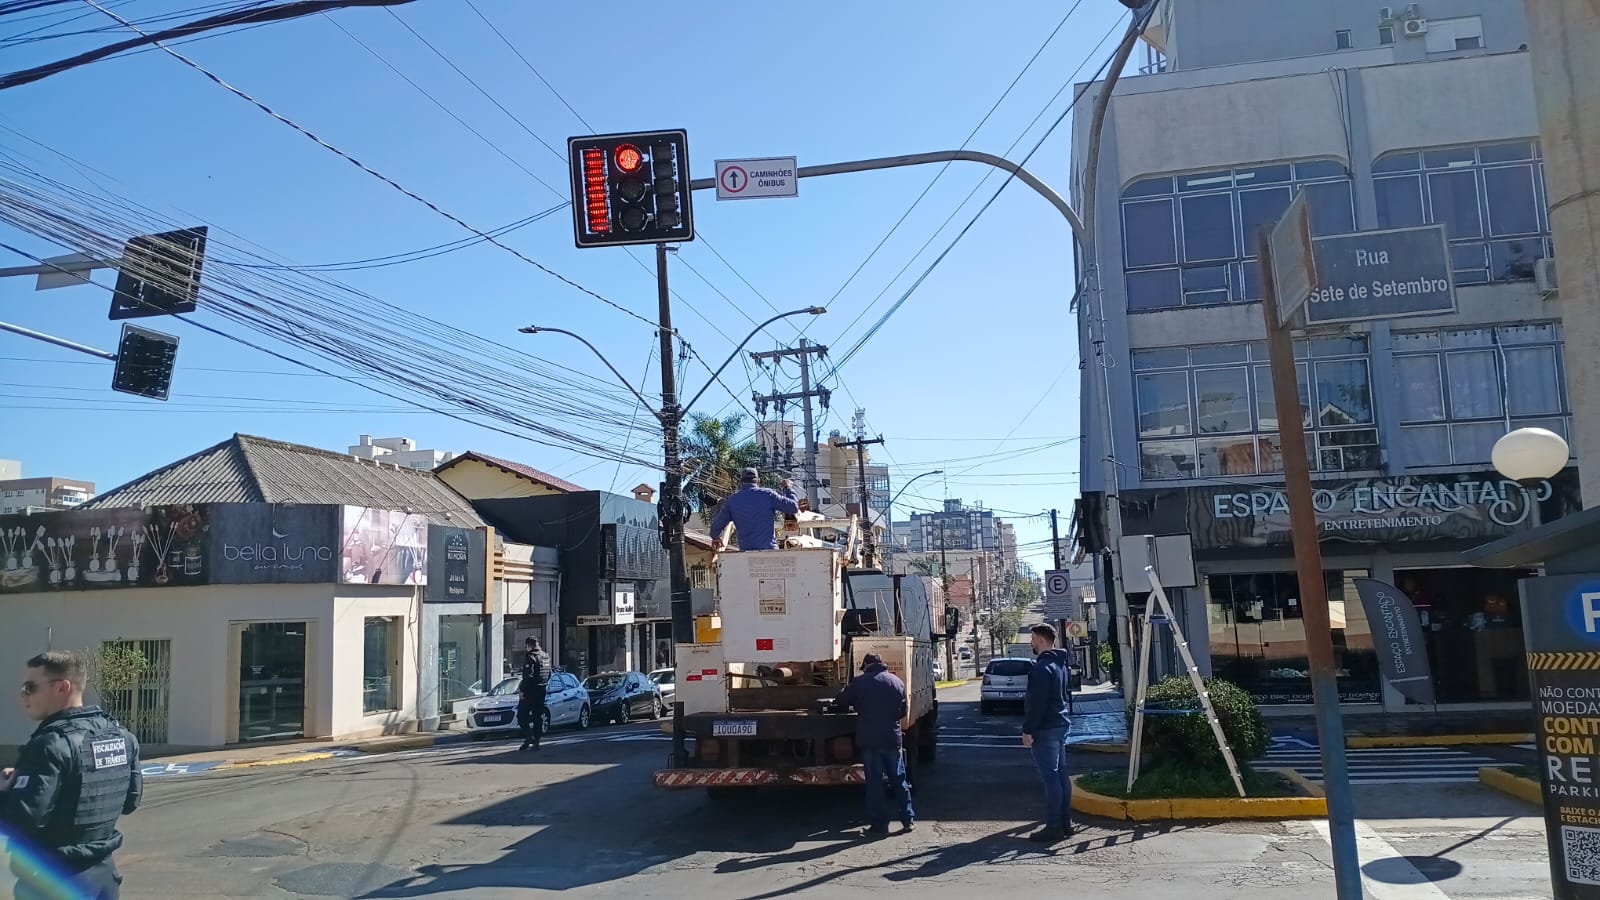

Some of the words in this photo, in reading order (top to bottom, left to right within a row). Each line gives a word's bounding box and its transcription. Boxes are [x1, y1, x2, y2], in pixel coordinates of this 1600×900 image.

[750, 168, 793, 178] CAMINHÕES
[758, 179, 786, 187] ÔNIBUS
[1355, 249, 1389, 267] Rua
[1310, 286, 1344, 303] Sete
[1349, 283, 1368, 300] de
[1372, 276, 1448, 298] Setembro
[1213, 489, 1337, 518] ESPAO
[1324, 515, 1442, 531] ENTRETENIMENTO
[224, 543, 277, 560] bella
[283, 543, 332, 560] luna
[1053, 578, 1063, 590] E
[1391, 642, 1406, 674] ESPAÇO
[1539, 685, 1563, 698] NÃO
[1541, 701, 1600, 714] MOEDA
[1546, 736, 1594, 754] COM
[1550, 784, 1599, 798] PARKI
[1560, 806, 1586, 816] BAIXE
[1588, 808, 1596, 816] O
[1560, 814, 1566, 822] E
[1566, 816, 1600, 824] ESTACI
